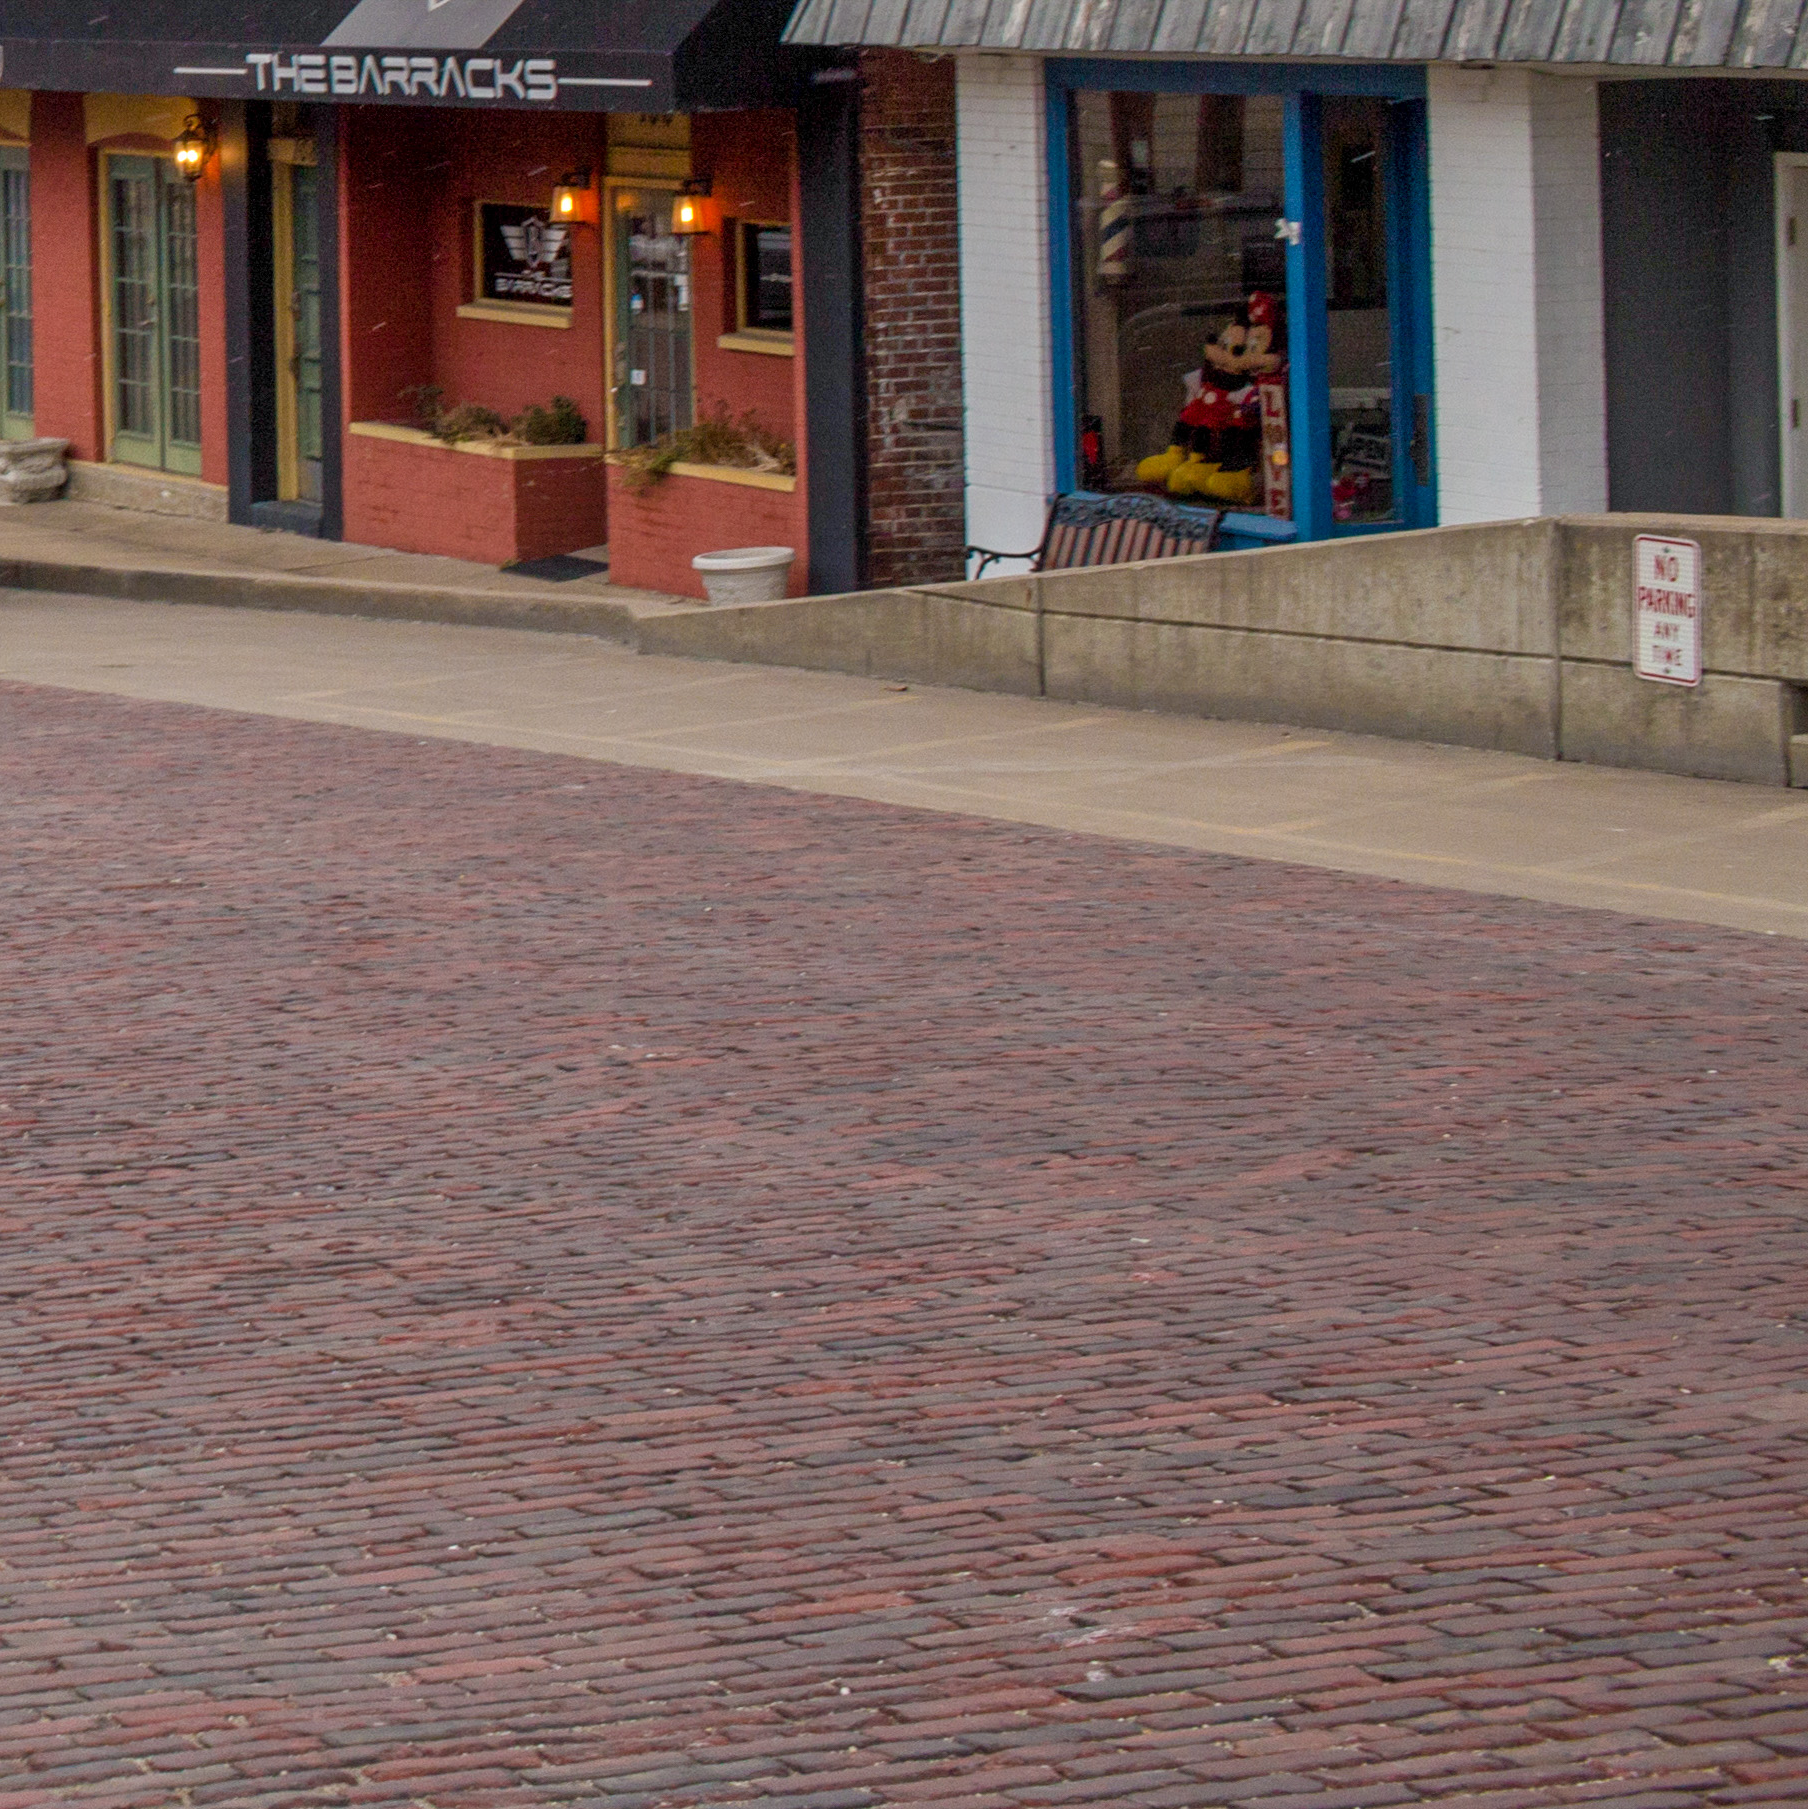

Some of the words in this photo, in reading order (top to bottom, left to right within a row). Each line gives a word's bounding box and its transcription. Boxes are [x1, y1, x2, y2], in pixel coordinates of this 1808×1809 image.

[331, 55, 557, 100] BARRACKS
[1653, 554, 1679, 582] NO
[1637, 586, 1696, 618] PARKING
[1653, 621, 1680, 641] ANY
[1652, 644, 1683, 667] TIME
